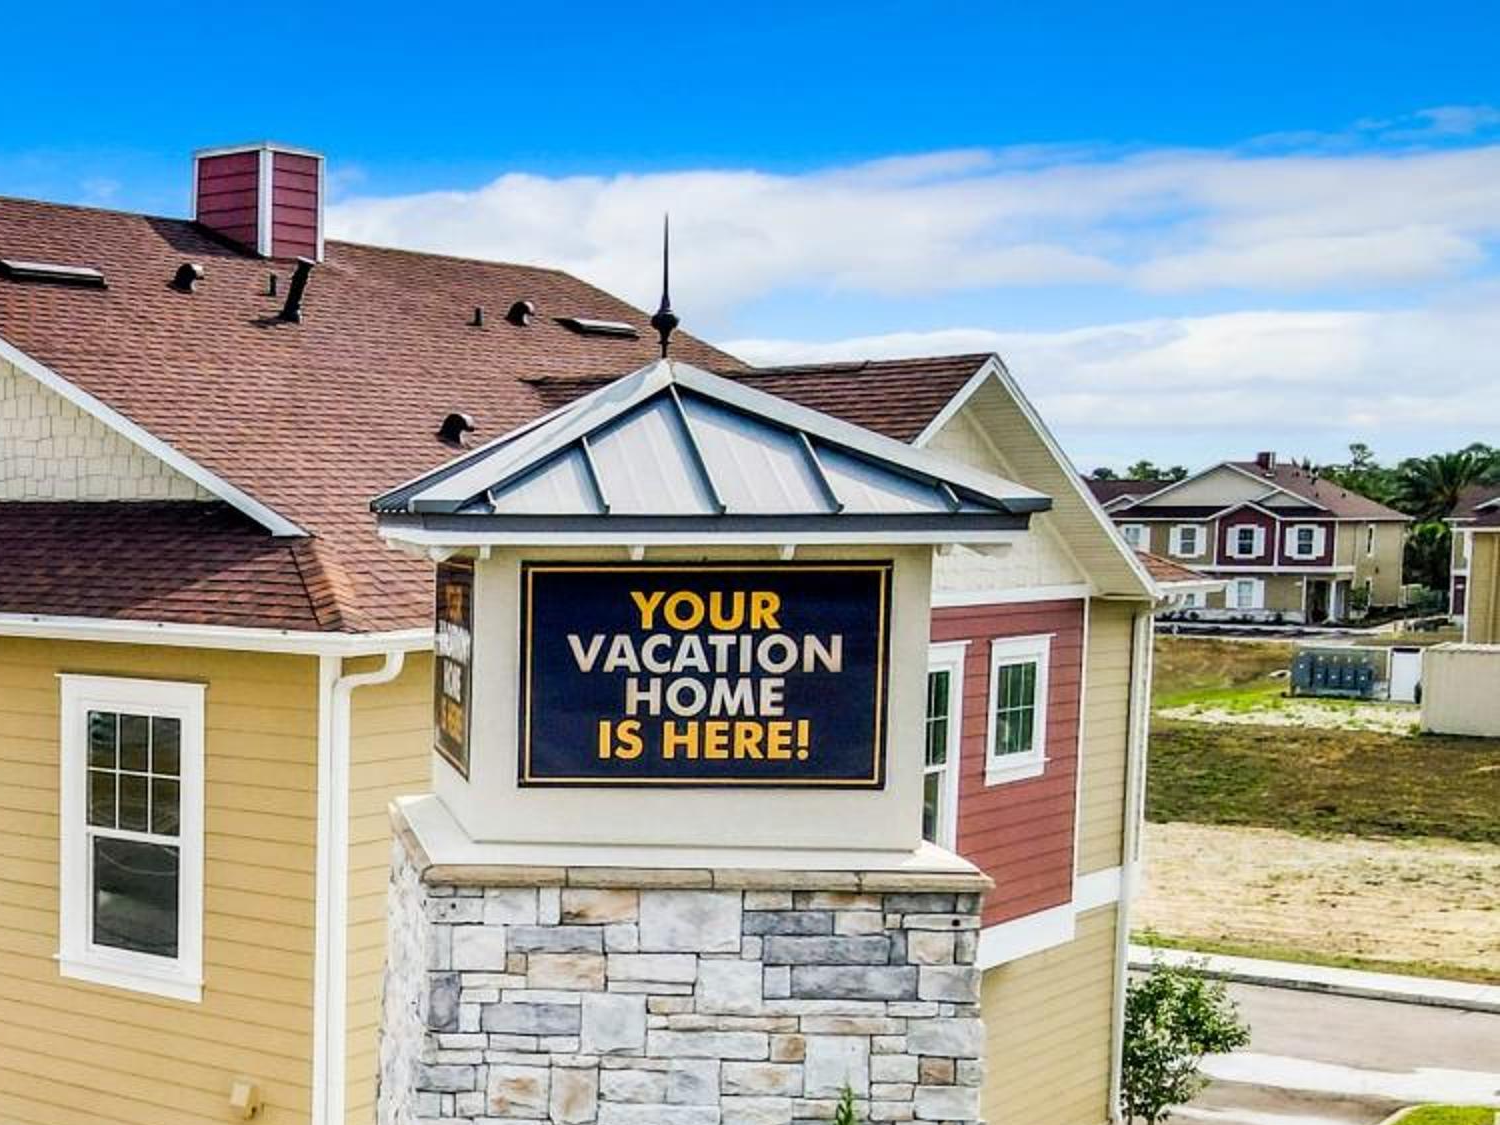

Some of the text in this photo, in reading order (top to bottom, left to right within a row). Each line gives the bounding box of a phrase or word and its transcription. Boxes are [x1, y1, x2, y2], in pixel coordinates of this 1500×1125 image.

[630, 591, 781, 630] YOUR
[567, 634, 843, 673] VACATION
[625, 678, 785, 717] HOME
[598, 720, 810, 760] IS HERE!
